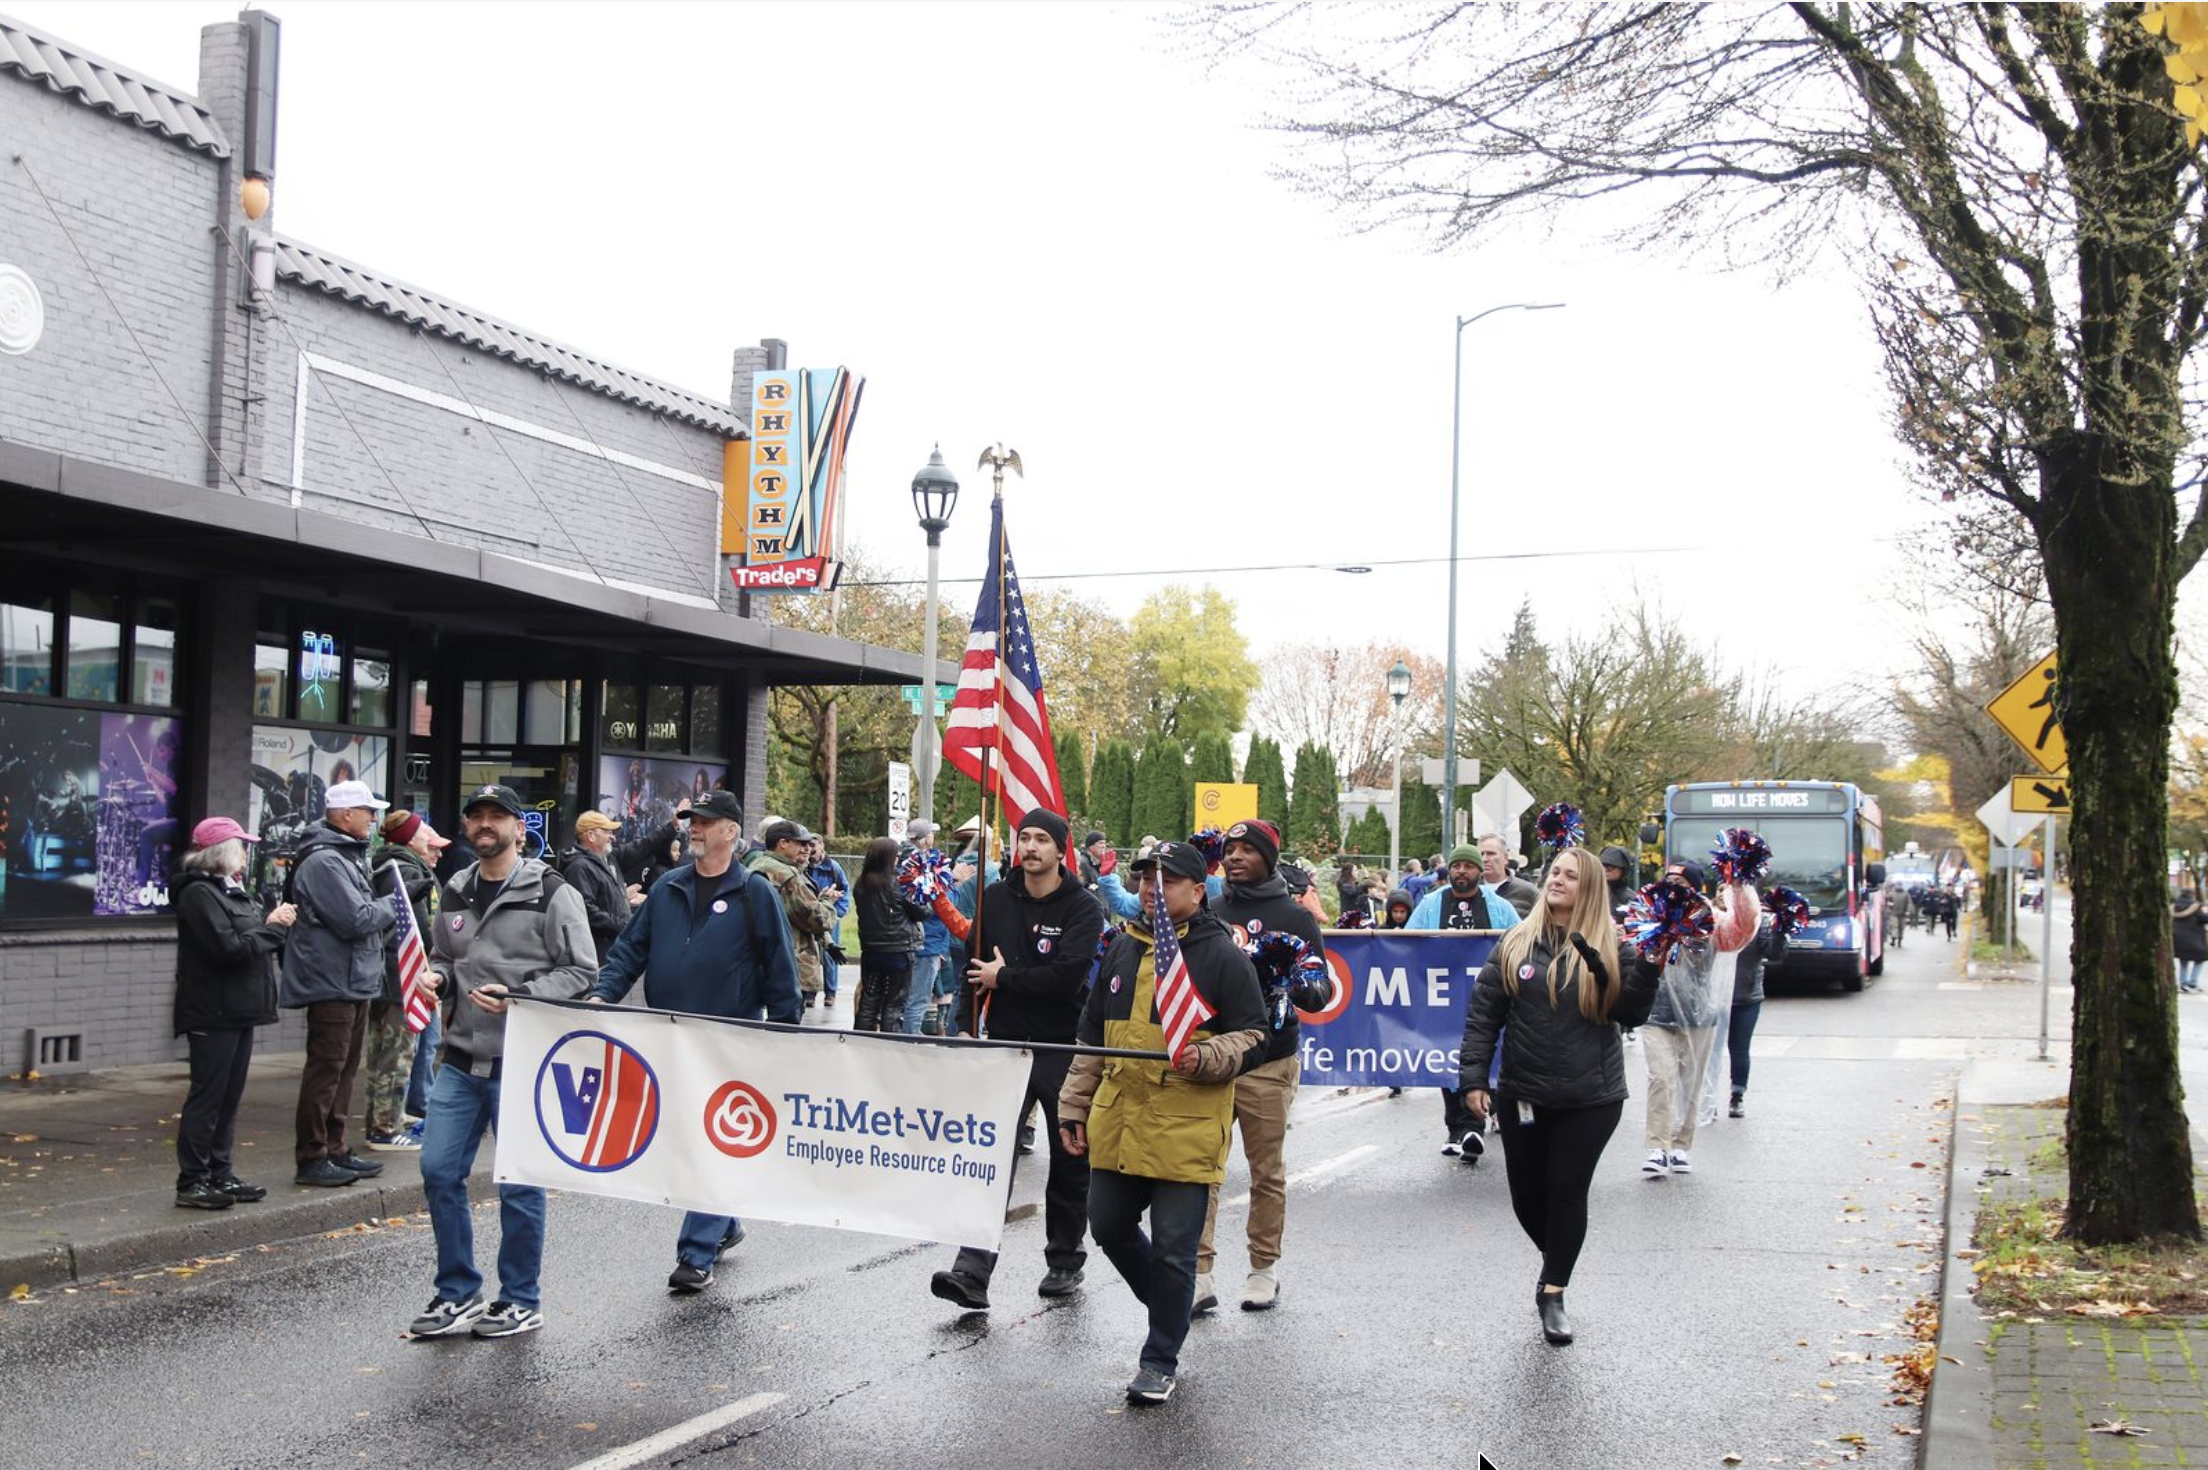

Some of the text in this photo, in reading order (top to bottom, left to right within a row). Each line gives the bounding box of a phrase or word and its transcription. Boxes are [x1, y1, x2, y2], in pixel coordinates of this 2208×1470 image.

[756, 384, 785, 554] RHYTHM
[737, 565, 817, 586] Traders
[626, 722, 677, 739] YAHA
[258, 737, 287, 750] Roland
[892, 791, 907, 812] 20
[1739, 793, 1766, 807] LIFE
[1769, 792, 1809, 807] MOVES
[1301, 1036, 1461, 1074] fe moves
[783, 1093, 997, 1147] TriMet-Vets
[786, 1135, 997, 1186] Employee Resource Group
